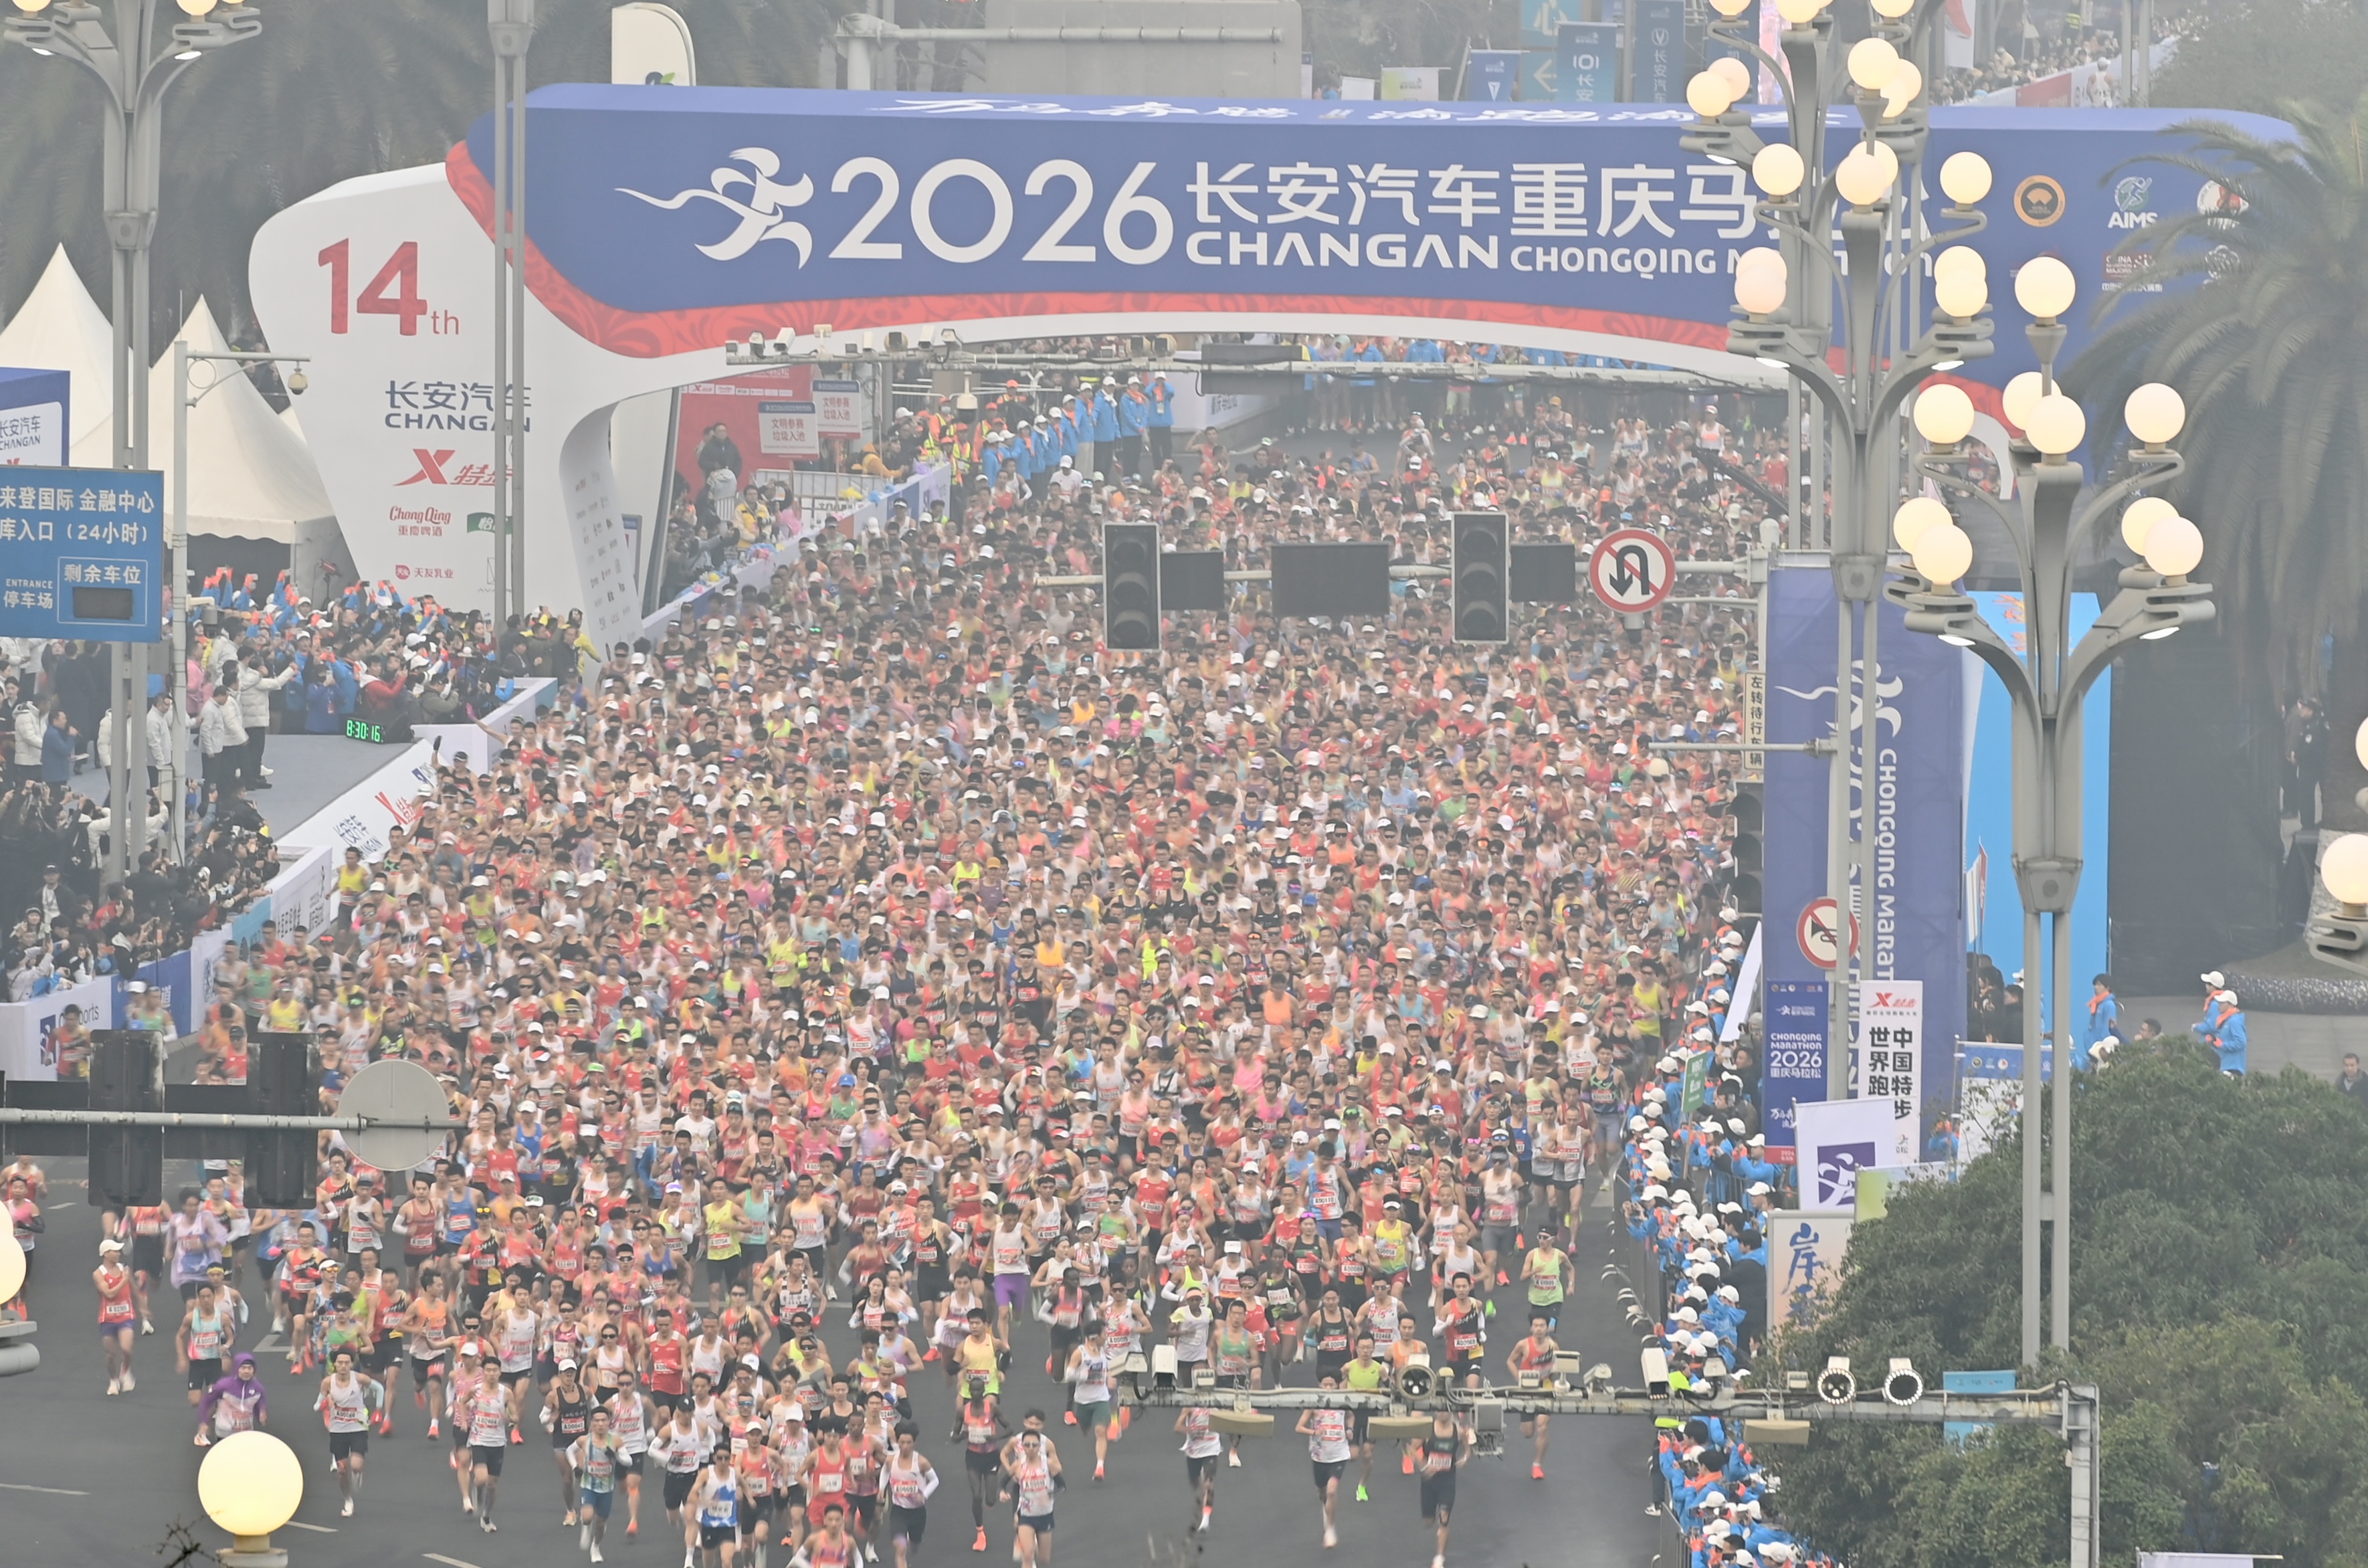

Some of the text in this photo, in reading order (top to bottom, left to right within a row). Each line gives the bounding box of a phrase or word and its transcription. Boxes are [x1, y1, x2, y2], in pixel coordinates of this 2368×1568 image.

[1186, 161, 1931, 239] 长安汽车重庆马
[829, 157, 1174, 265] 2026
[2108, 211, 2158, 229] AIMS
[1186, 231, 1498, 269] CHANGAN
[64, 564, 141, 584] 剩余车位
[6, 579, 53, 589] ENTRANCE
[3, 590, 54, 609] 停车场
[1770, 1050, 1823, 1068] 2026
[1770, 1067, 1822, 1079] 重庆马拉松
